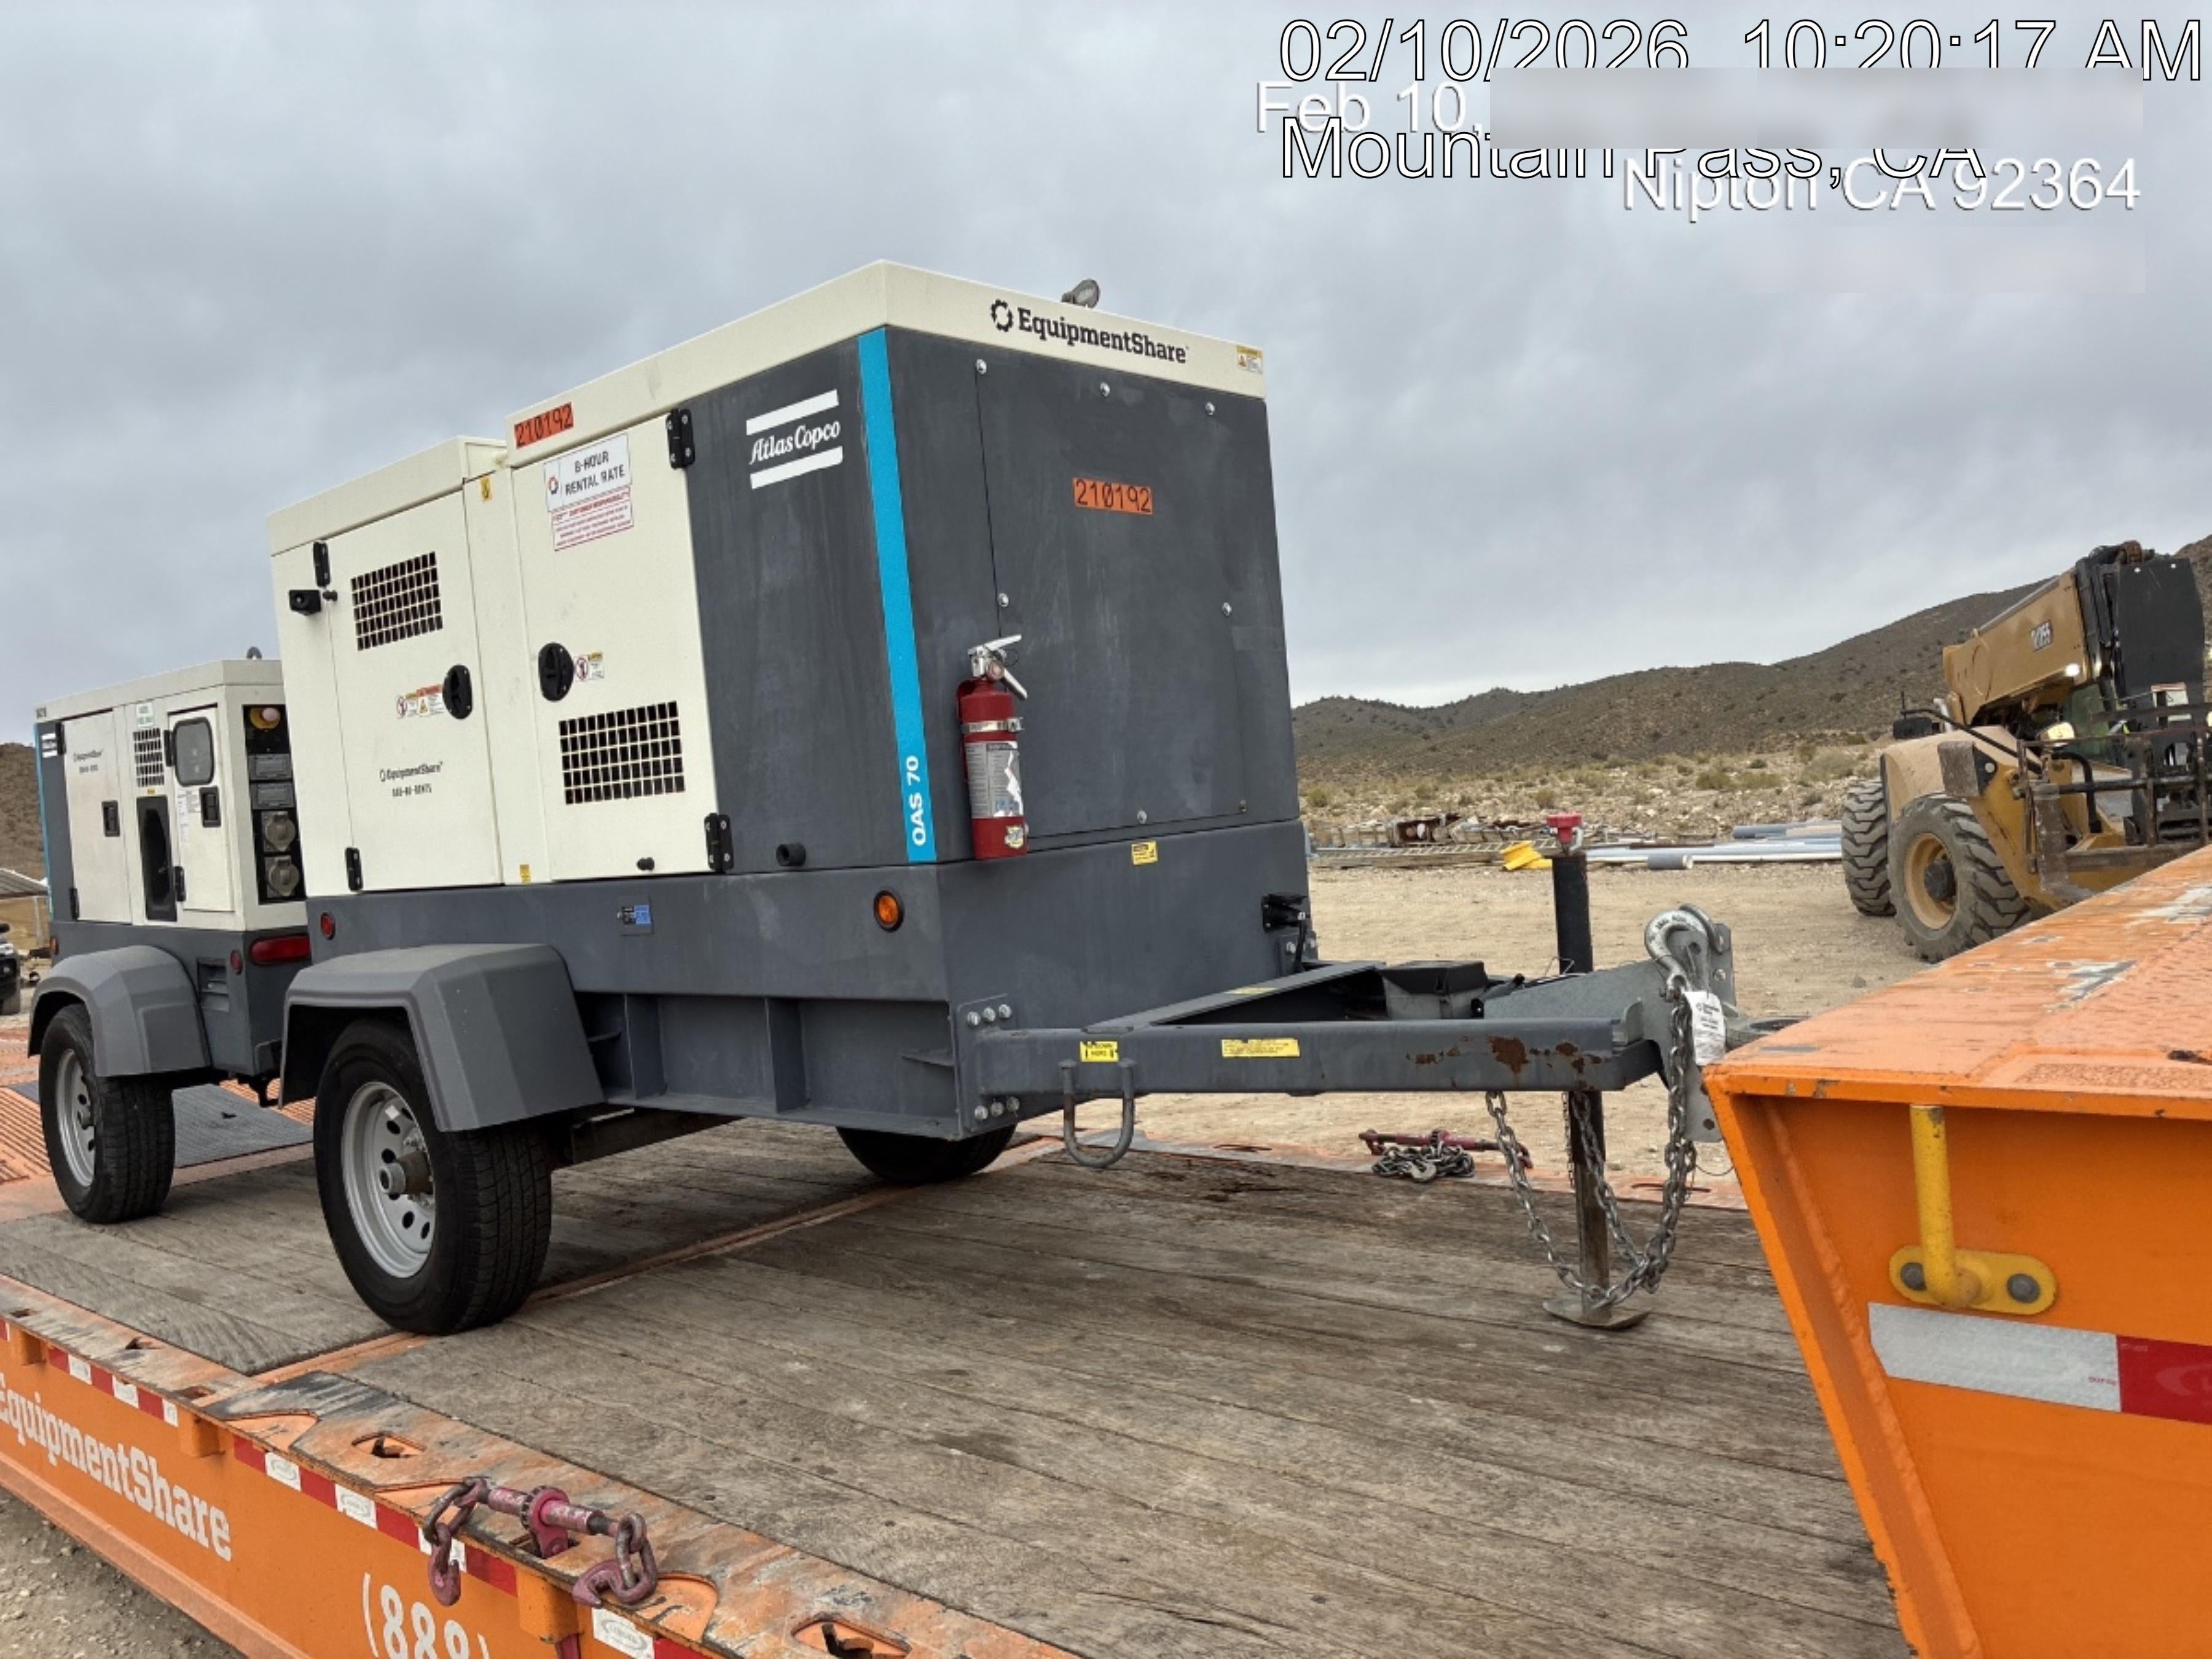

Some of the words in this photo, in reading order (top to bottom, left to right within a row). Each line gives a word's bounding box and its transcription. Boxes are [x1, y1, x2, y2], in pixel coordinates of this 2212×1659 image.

[1017, 307, 1186, 364] EquipmentShare
[514, 402, 573, 449] 210192
[748, 434, 794, 465] Atlas
[794, 420, 841, 450] Copco
[565, 474, 599, 495] RENTAL
[600, 464, 626, 483] RATE
[1076, 479, 1151, 512] 210192
[906, 755, 920, 786] 70
[362, 1572, 491, 1659] (88
